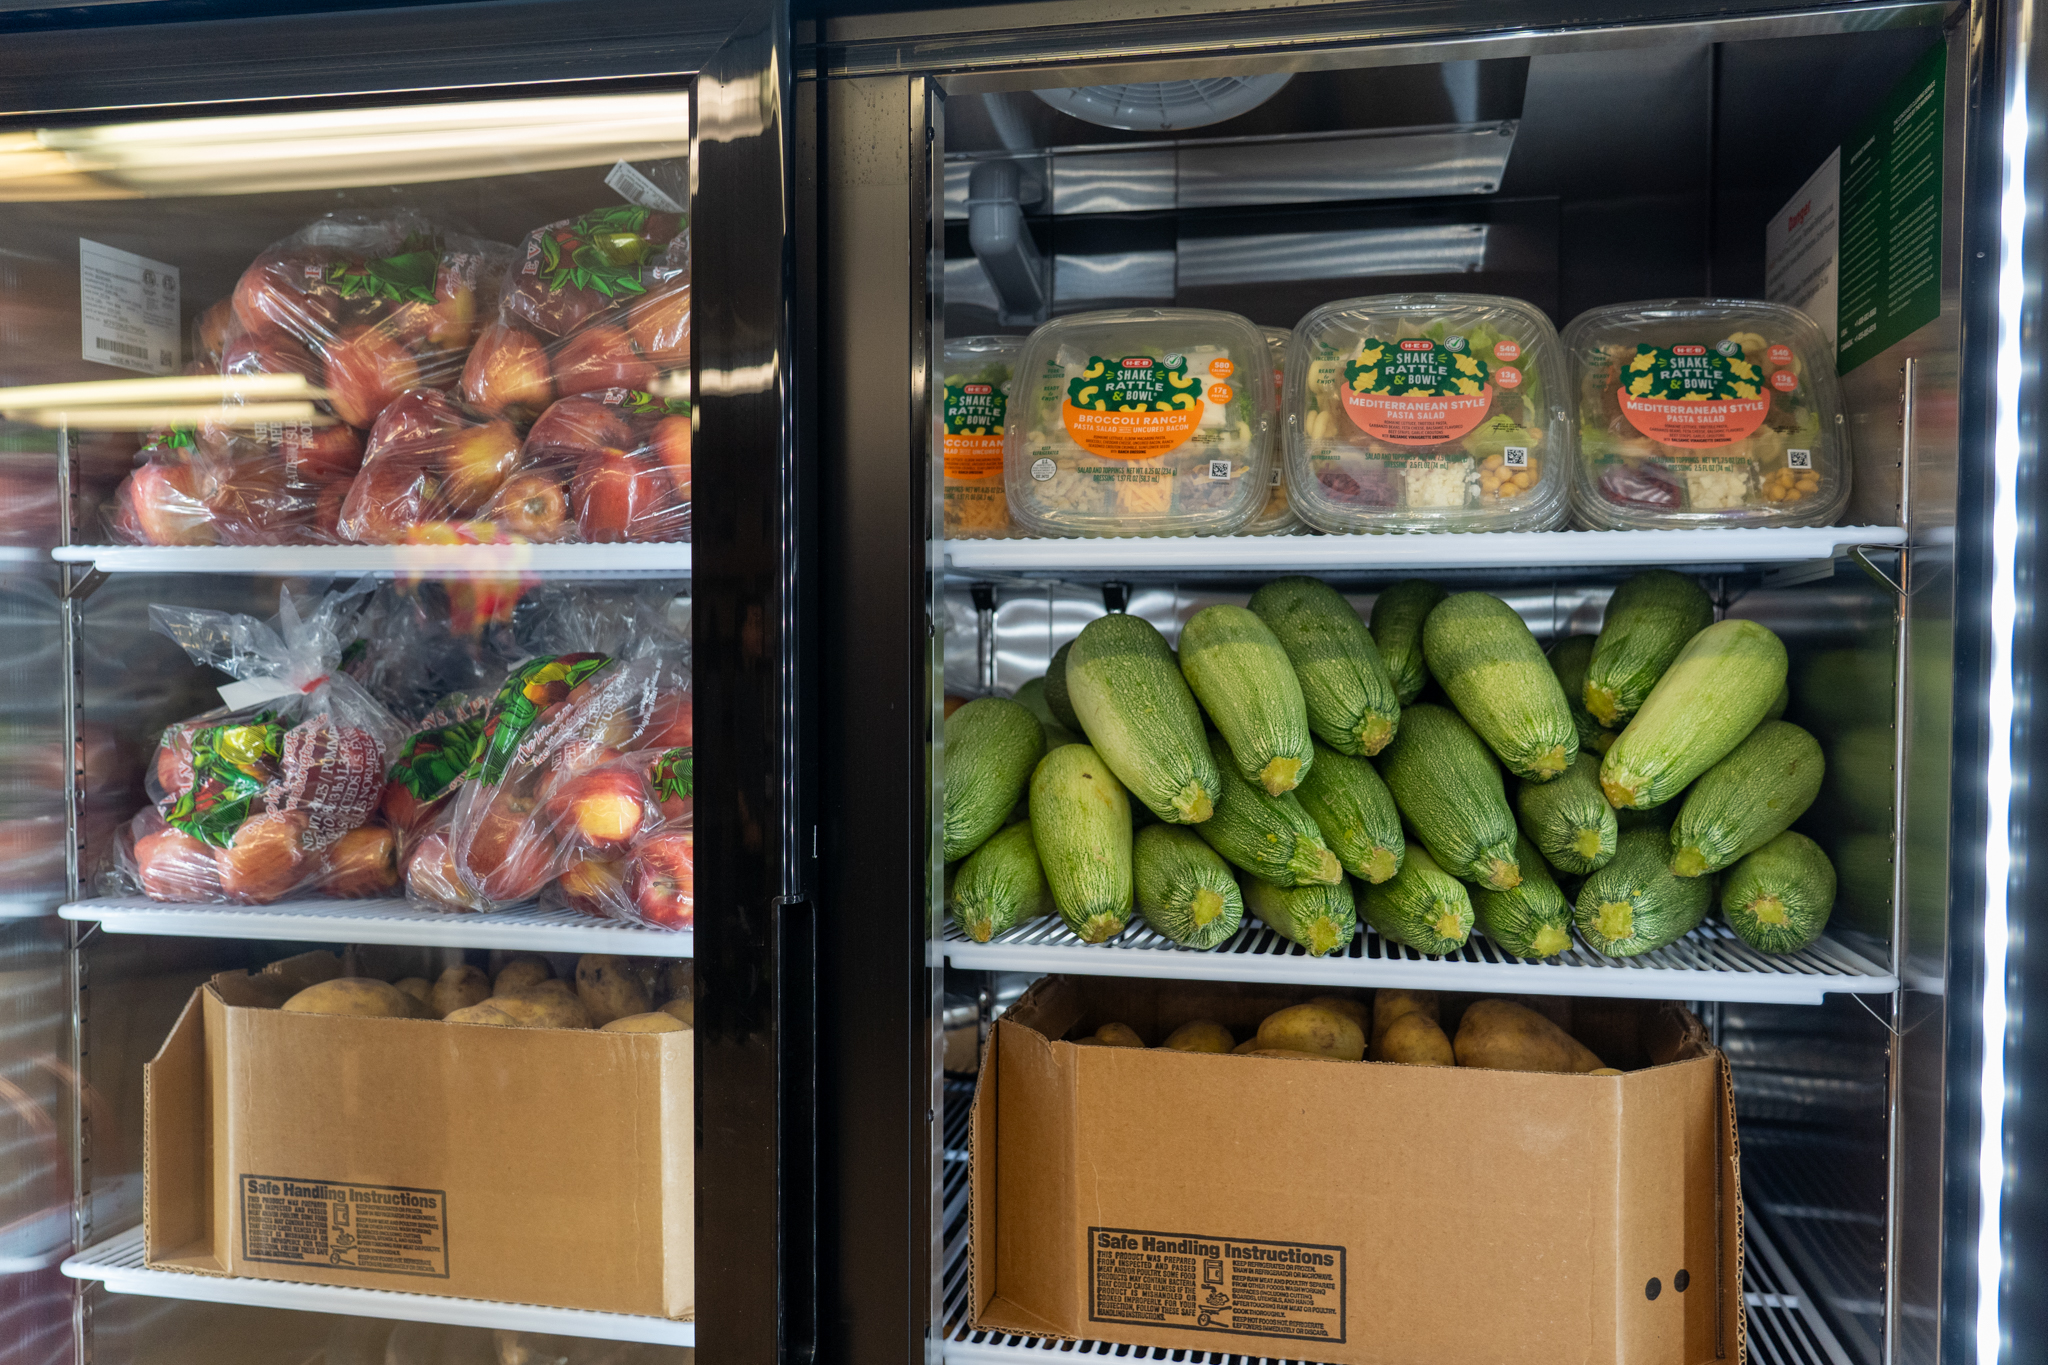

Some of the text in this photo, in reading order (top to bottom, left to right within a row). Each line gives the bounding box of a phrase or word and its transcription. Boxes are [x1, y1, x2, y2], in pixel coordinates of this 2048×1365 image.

[1396, 353, 1438, 365] SHAKE,
[1670, 358, 1713, 370] SHAKE,
[1385, 365, 1448, 376] RATTLE
[1660, 369, 1723, 379] RATTLE
[1117, 370, 1155, 382] SHAKE,
[1394, 376, 1405, 385] &
[1105, 382, 1164, 391] RATTLE
[959, 396, 993, 407] SHAKE,
[1112, 392, 1124, 401] &
[1349, 397, 1448, 411] MEDITERRANEAN
[1451, 398, 1485, 409] STYLE
[1627, 401, 1764, 414] MEDITERRANEAN STYLE
[948, 407, 1001, 416] RATTLE
[1387, 411, 1445, 419] PASTA SALAD
[1079, 415, 1187, 425] BROCCOLI RANCH
[1667, 415, 1694, 423] PASTA
[1074, 423, 1094, 431] PASTA
[247, 1180, 437, 1209] Safe Handling Instructions
[1097, 1234, 1334, 1266] Safe Handling Instructions
[1119, 1260, 1152, 1268] INSPECTED
[1164, 1256, 1196, 1264] PREPARED
[1098, 1273, 1127, 1281] PRODUCTS
[1098, 1287, 1127, 1295] PRODUCT
[1142, 1291, 1182, 1300] MISHANDLED
